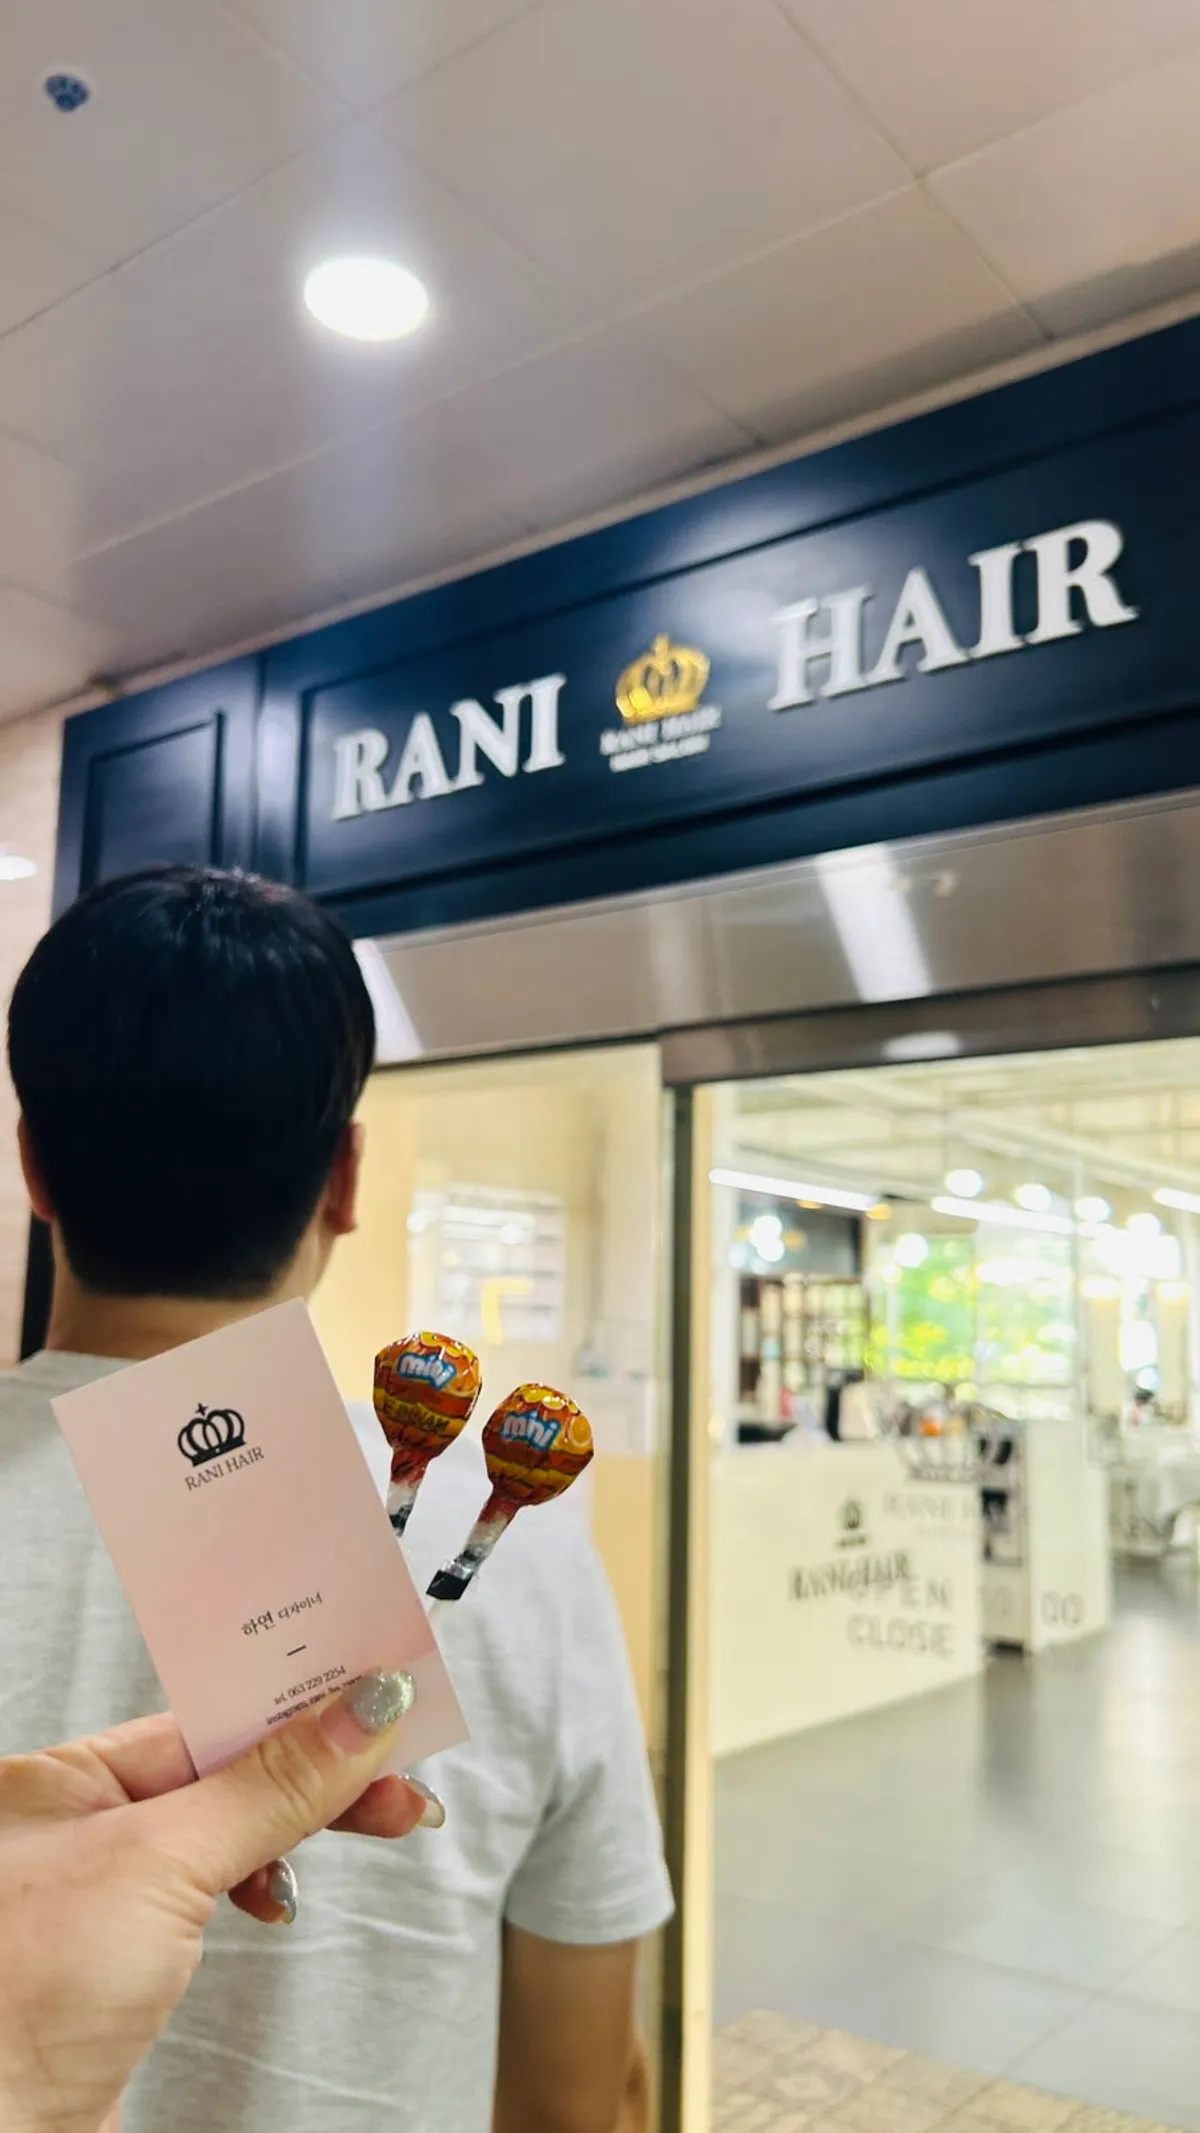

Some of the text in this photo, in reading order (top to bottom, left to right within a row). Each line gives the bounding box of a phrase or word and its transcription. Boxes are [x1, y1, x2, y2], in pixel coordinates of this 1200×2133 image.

[331, 519, 1140, 820] RANI HAIR
[503, 1410, 560, 1446] mini
[184, 1446, 265, 1491] RANI HAIR
[241, 1592, 323, 1636] 하연 디자이너
[322, 1665, 347, 1683] 2254
